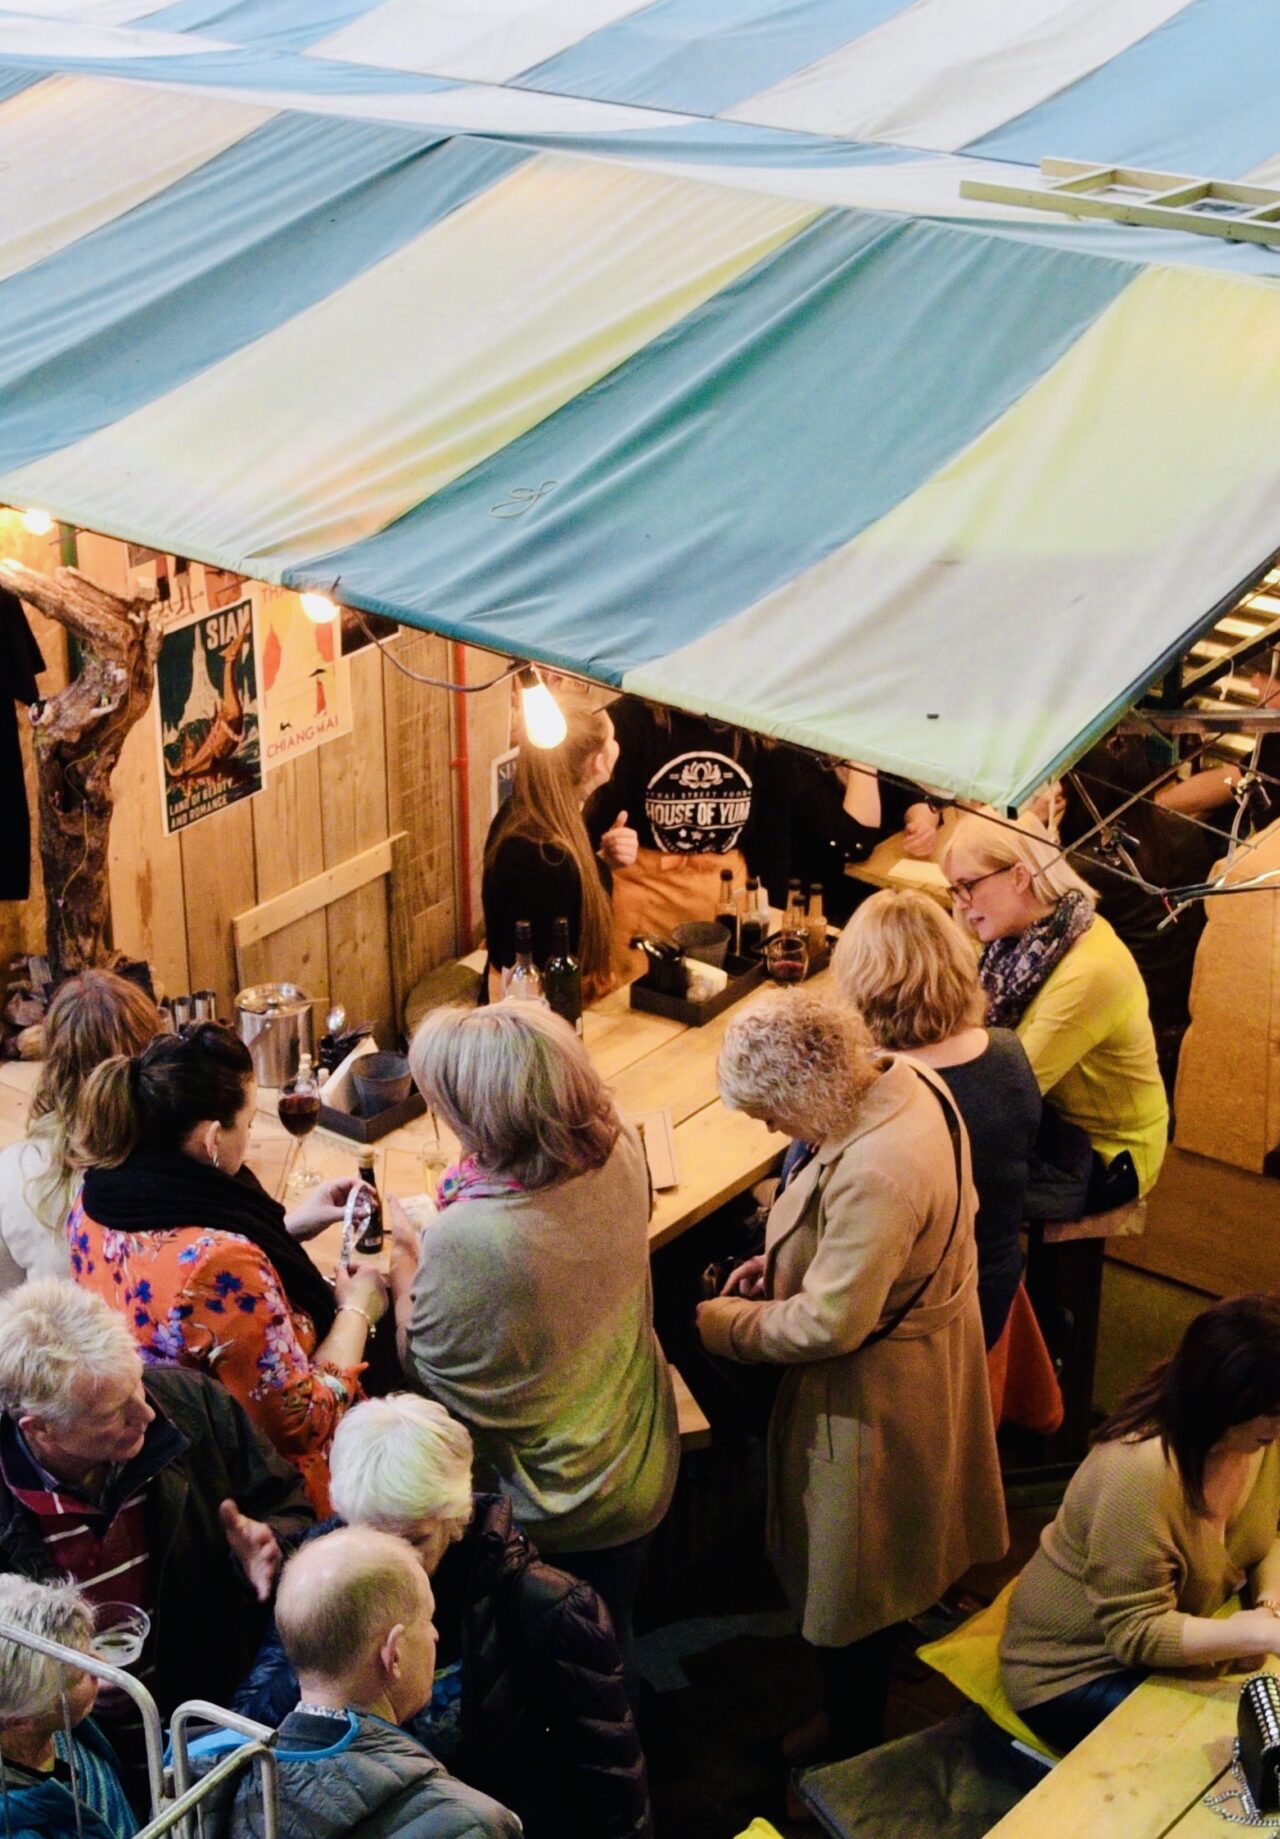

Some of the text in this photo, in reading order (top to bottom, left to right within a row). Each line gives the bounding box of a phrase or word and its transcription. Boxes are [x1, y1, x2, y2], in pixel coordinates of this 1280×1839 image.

[267, 714, 338, 759] CHIANG MAI
[169, 799, 190, 816] LAND
[171, 793, 228, 829] AND ROMANCE
[645, 800, 751, 826] HOUSE OF YUM
